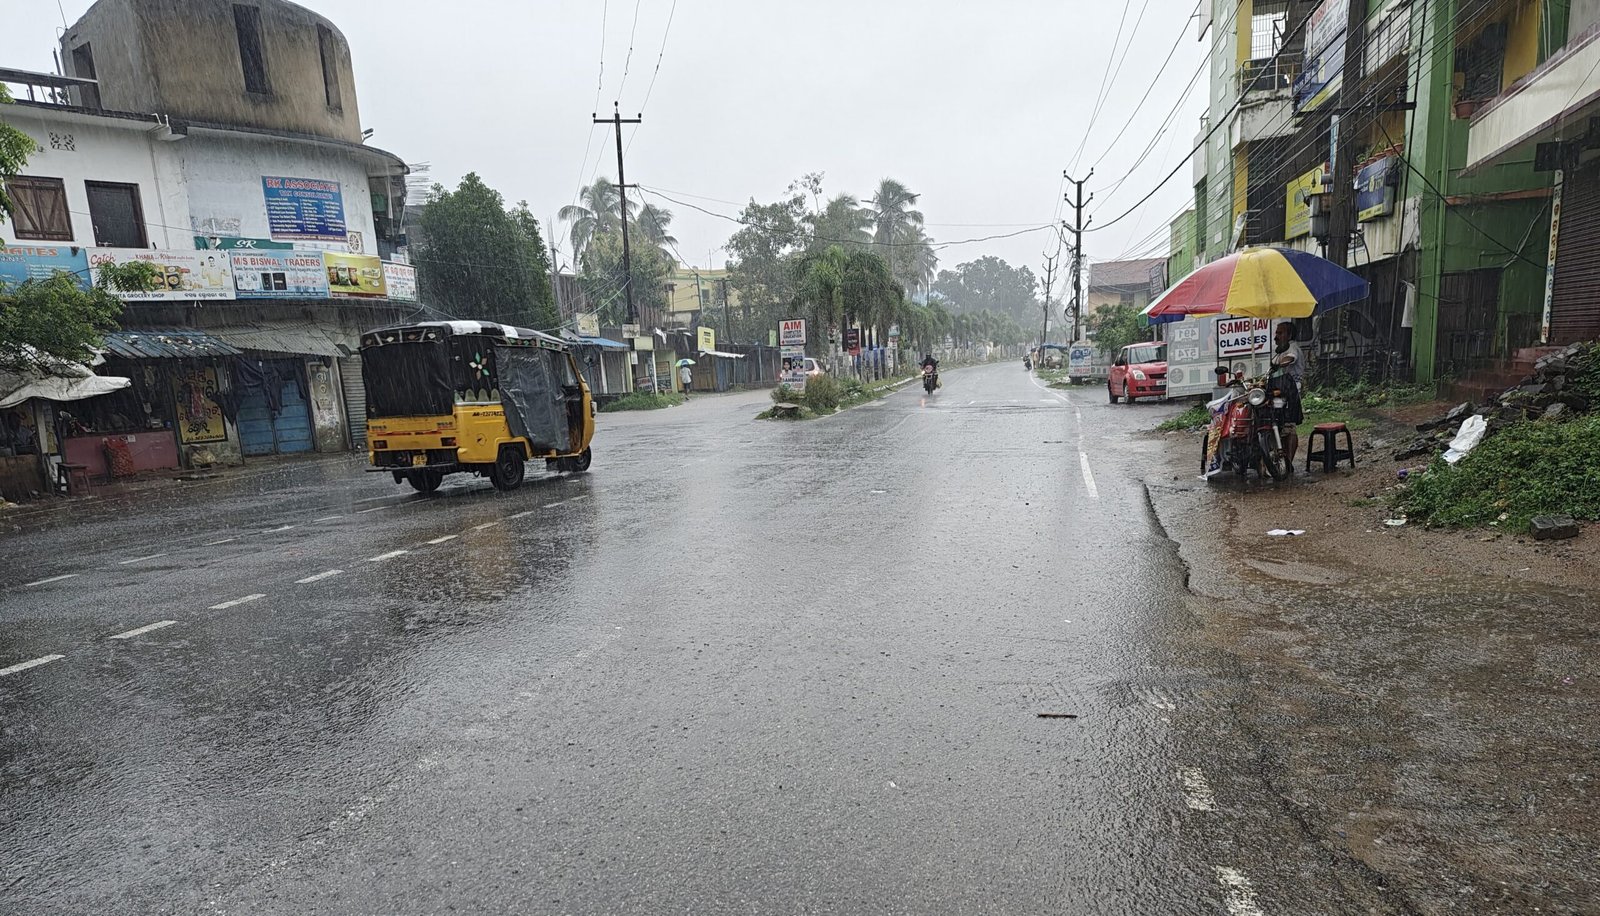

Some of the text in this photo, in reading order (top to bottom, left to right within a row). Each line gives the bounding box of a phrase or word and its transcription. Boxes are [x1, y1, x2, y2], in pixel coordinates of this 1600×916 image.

[266, 179, 283, 189] RK
[234, 239, 258, 249] SR
[90, 253, 116, 265] Catch
[233, 257, 321, 267] M/S BISWAL TRADERS
[783, 320, 802, 330] AIM
[1220, 319, 1269, 335] SAMBHAV
[1220, 335, 1268, 348] CLASSES
